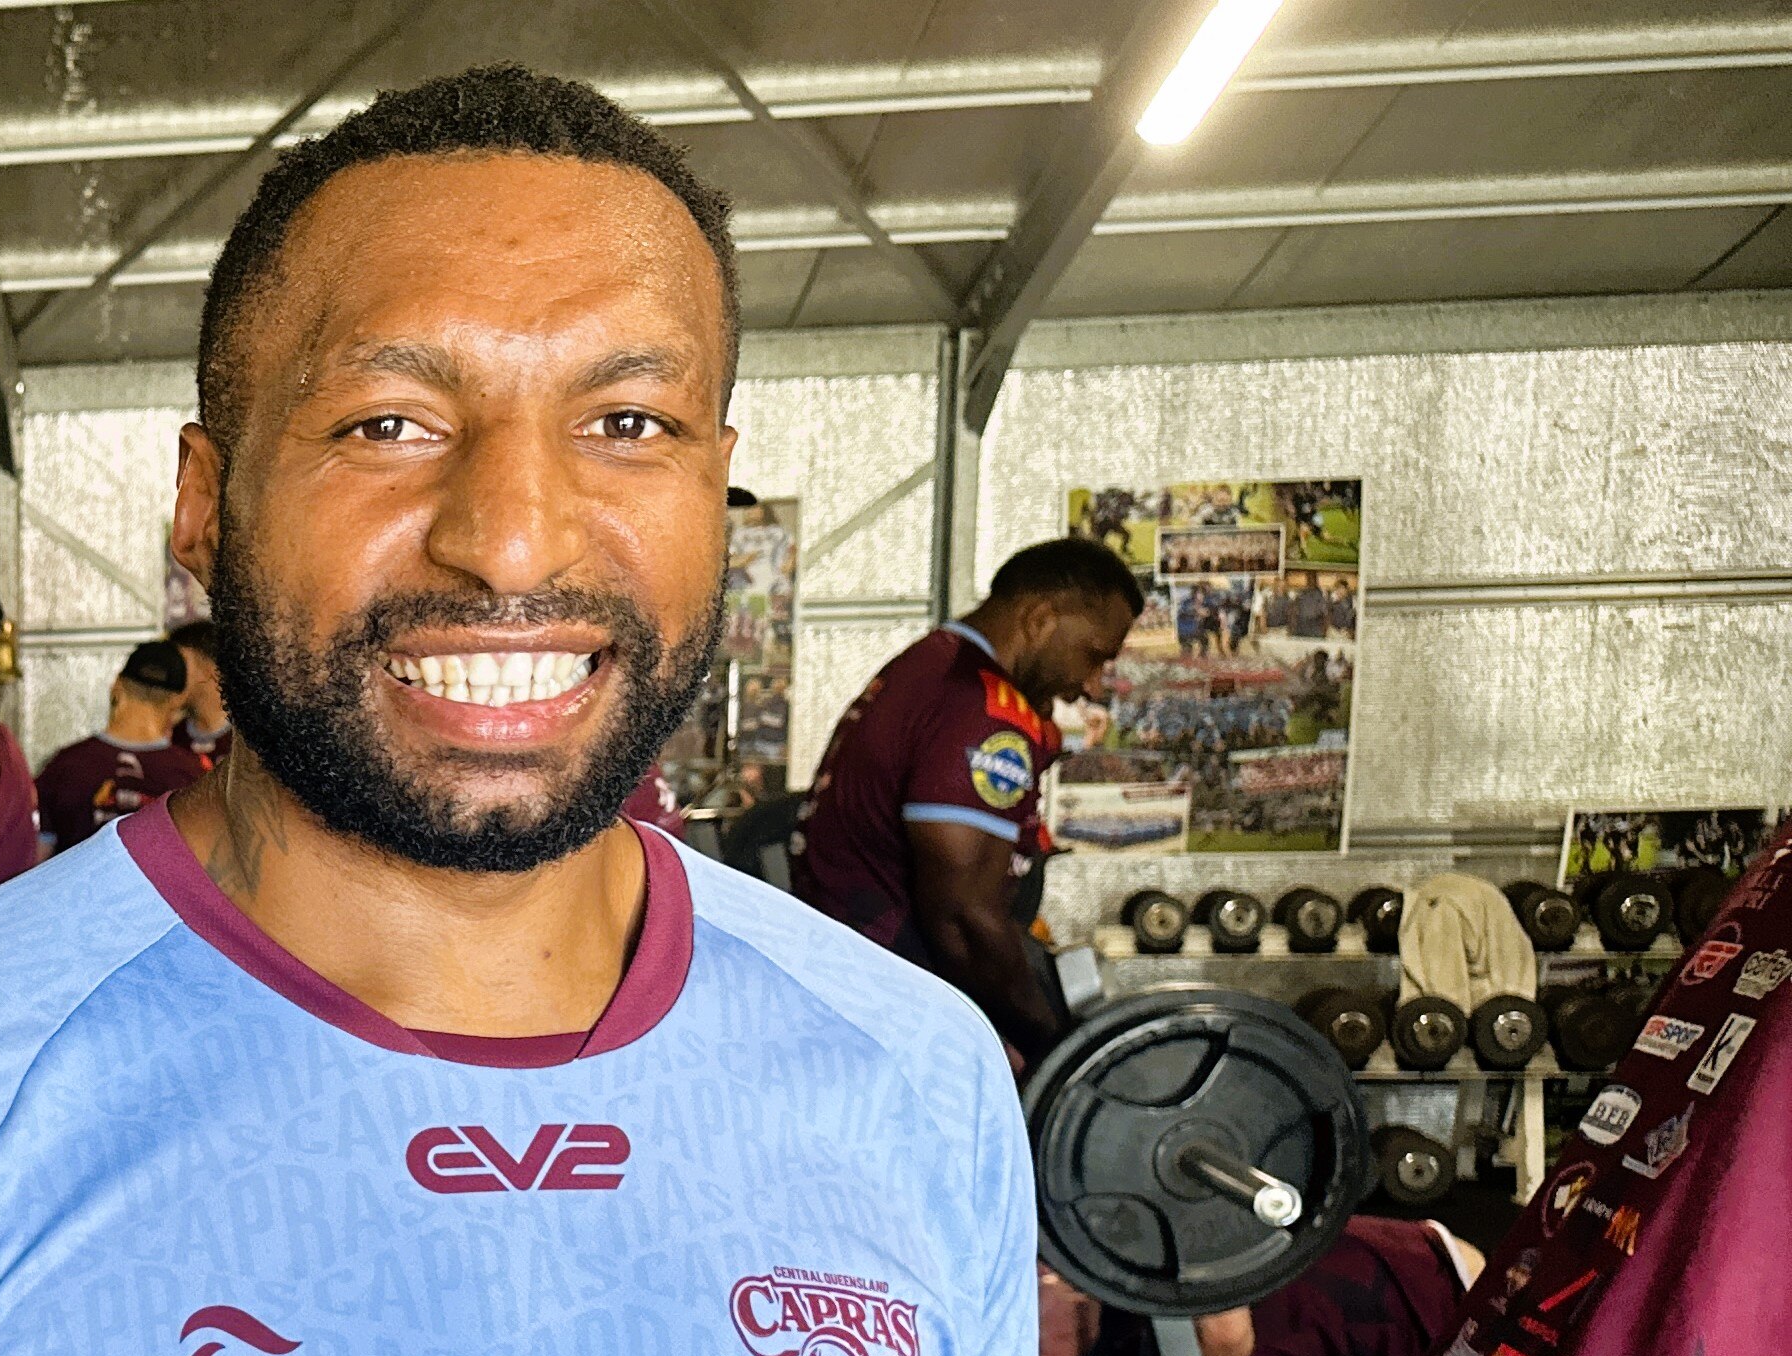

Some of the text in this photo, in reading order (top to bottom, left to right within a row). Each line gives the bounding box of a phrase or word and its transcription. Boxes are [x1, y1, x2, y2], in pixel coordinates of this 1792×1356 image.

[406, 1123, 632, 1194] EV2
[773, 1265, 889, 1294] CENTRAL QUEENSLAND
